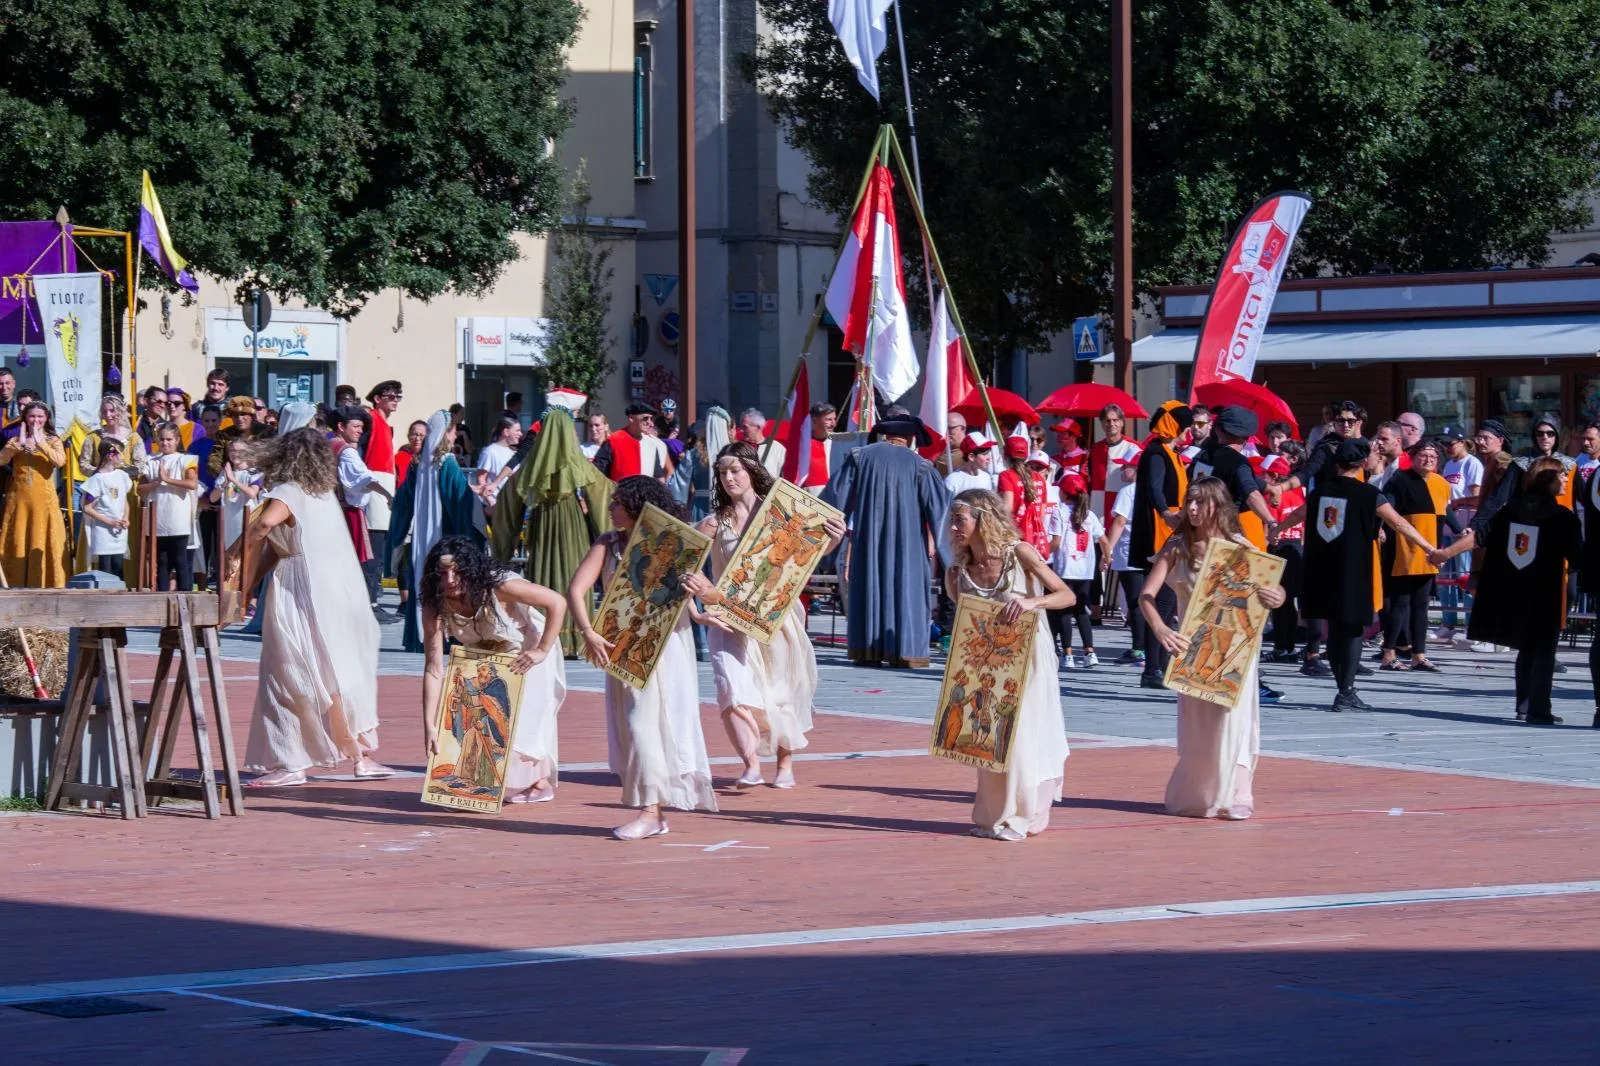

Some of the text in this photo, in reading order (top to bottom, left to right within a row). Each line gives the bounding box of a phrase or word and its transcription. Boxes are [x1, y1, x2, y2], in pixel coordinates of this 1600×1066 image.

[51, 292, 85, 305] rione
[243, 334, 305, 357] Oeanya.it
[726, 611, 755, 633] DIABLE
[430, 793, 443, 803] LE
